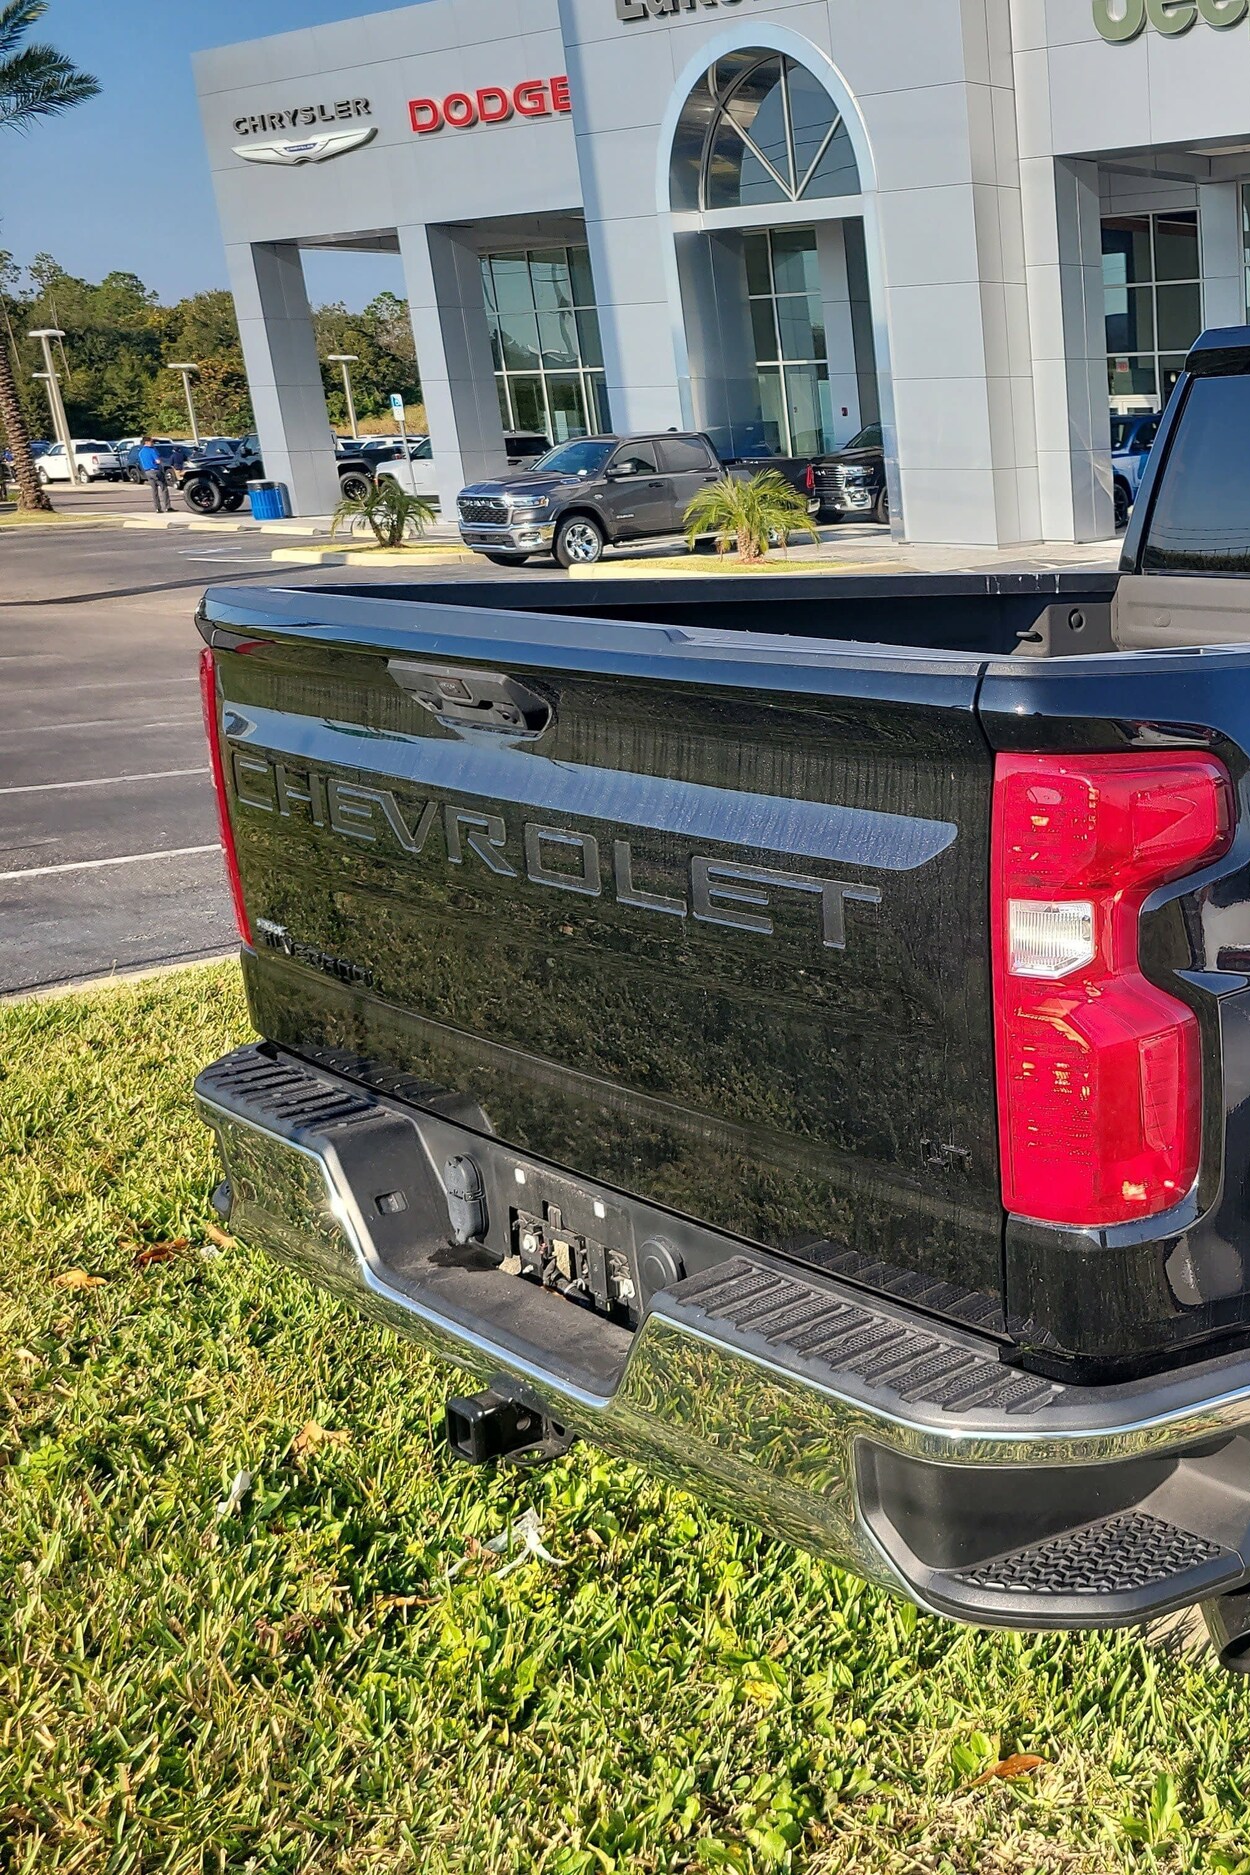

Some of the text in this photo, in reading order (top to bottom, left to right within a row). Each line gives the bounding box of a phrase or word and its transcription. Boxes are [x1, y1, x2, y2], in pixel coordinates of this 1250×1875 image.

[233, 98, 372, 135] CHRYSLER
[408, 75, 571, 133] DODGE
[233, 752, 882, 948] CHEVROLET
